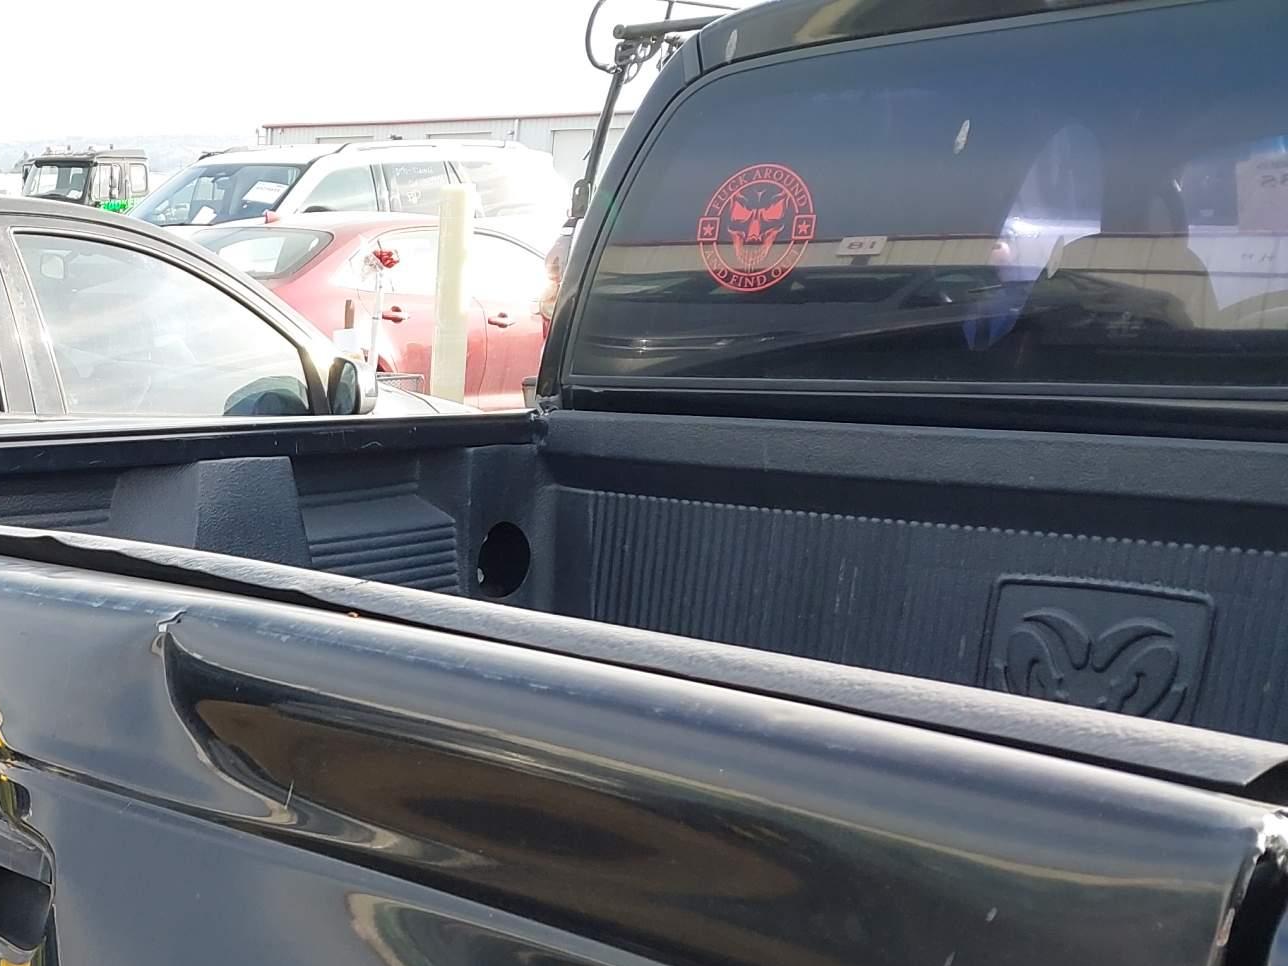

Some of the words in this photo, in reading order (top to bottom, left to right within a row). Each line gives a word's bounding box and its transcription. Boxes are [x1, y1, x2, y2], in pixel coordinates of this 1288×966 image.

[713, 172, 749, 211] FUCK
[753, 167, 808, 207] AROUND
[705, 250, 728, 278] AND
[730, 274, 767, 288] FIND
